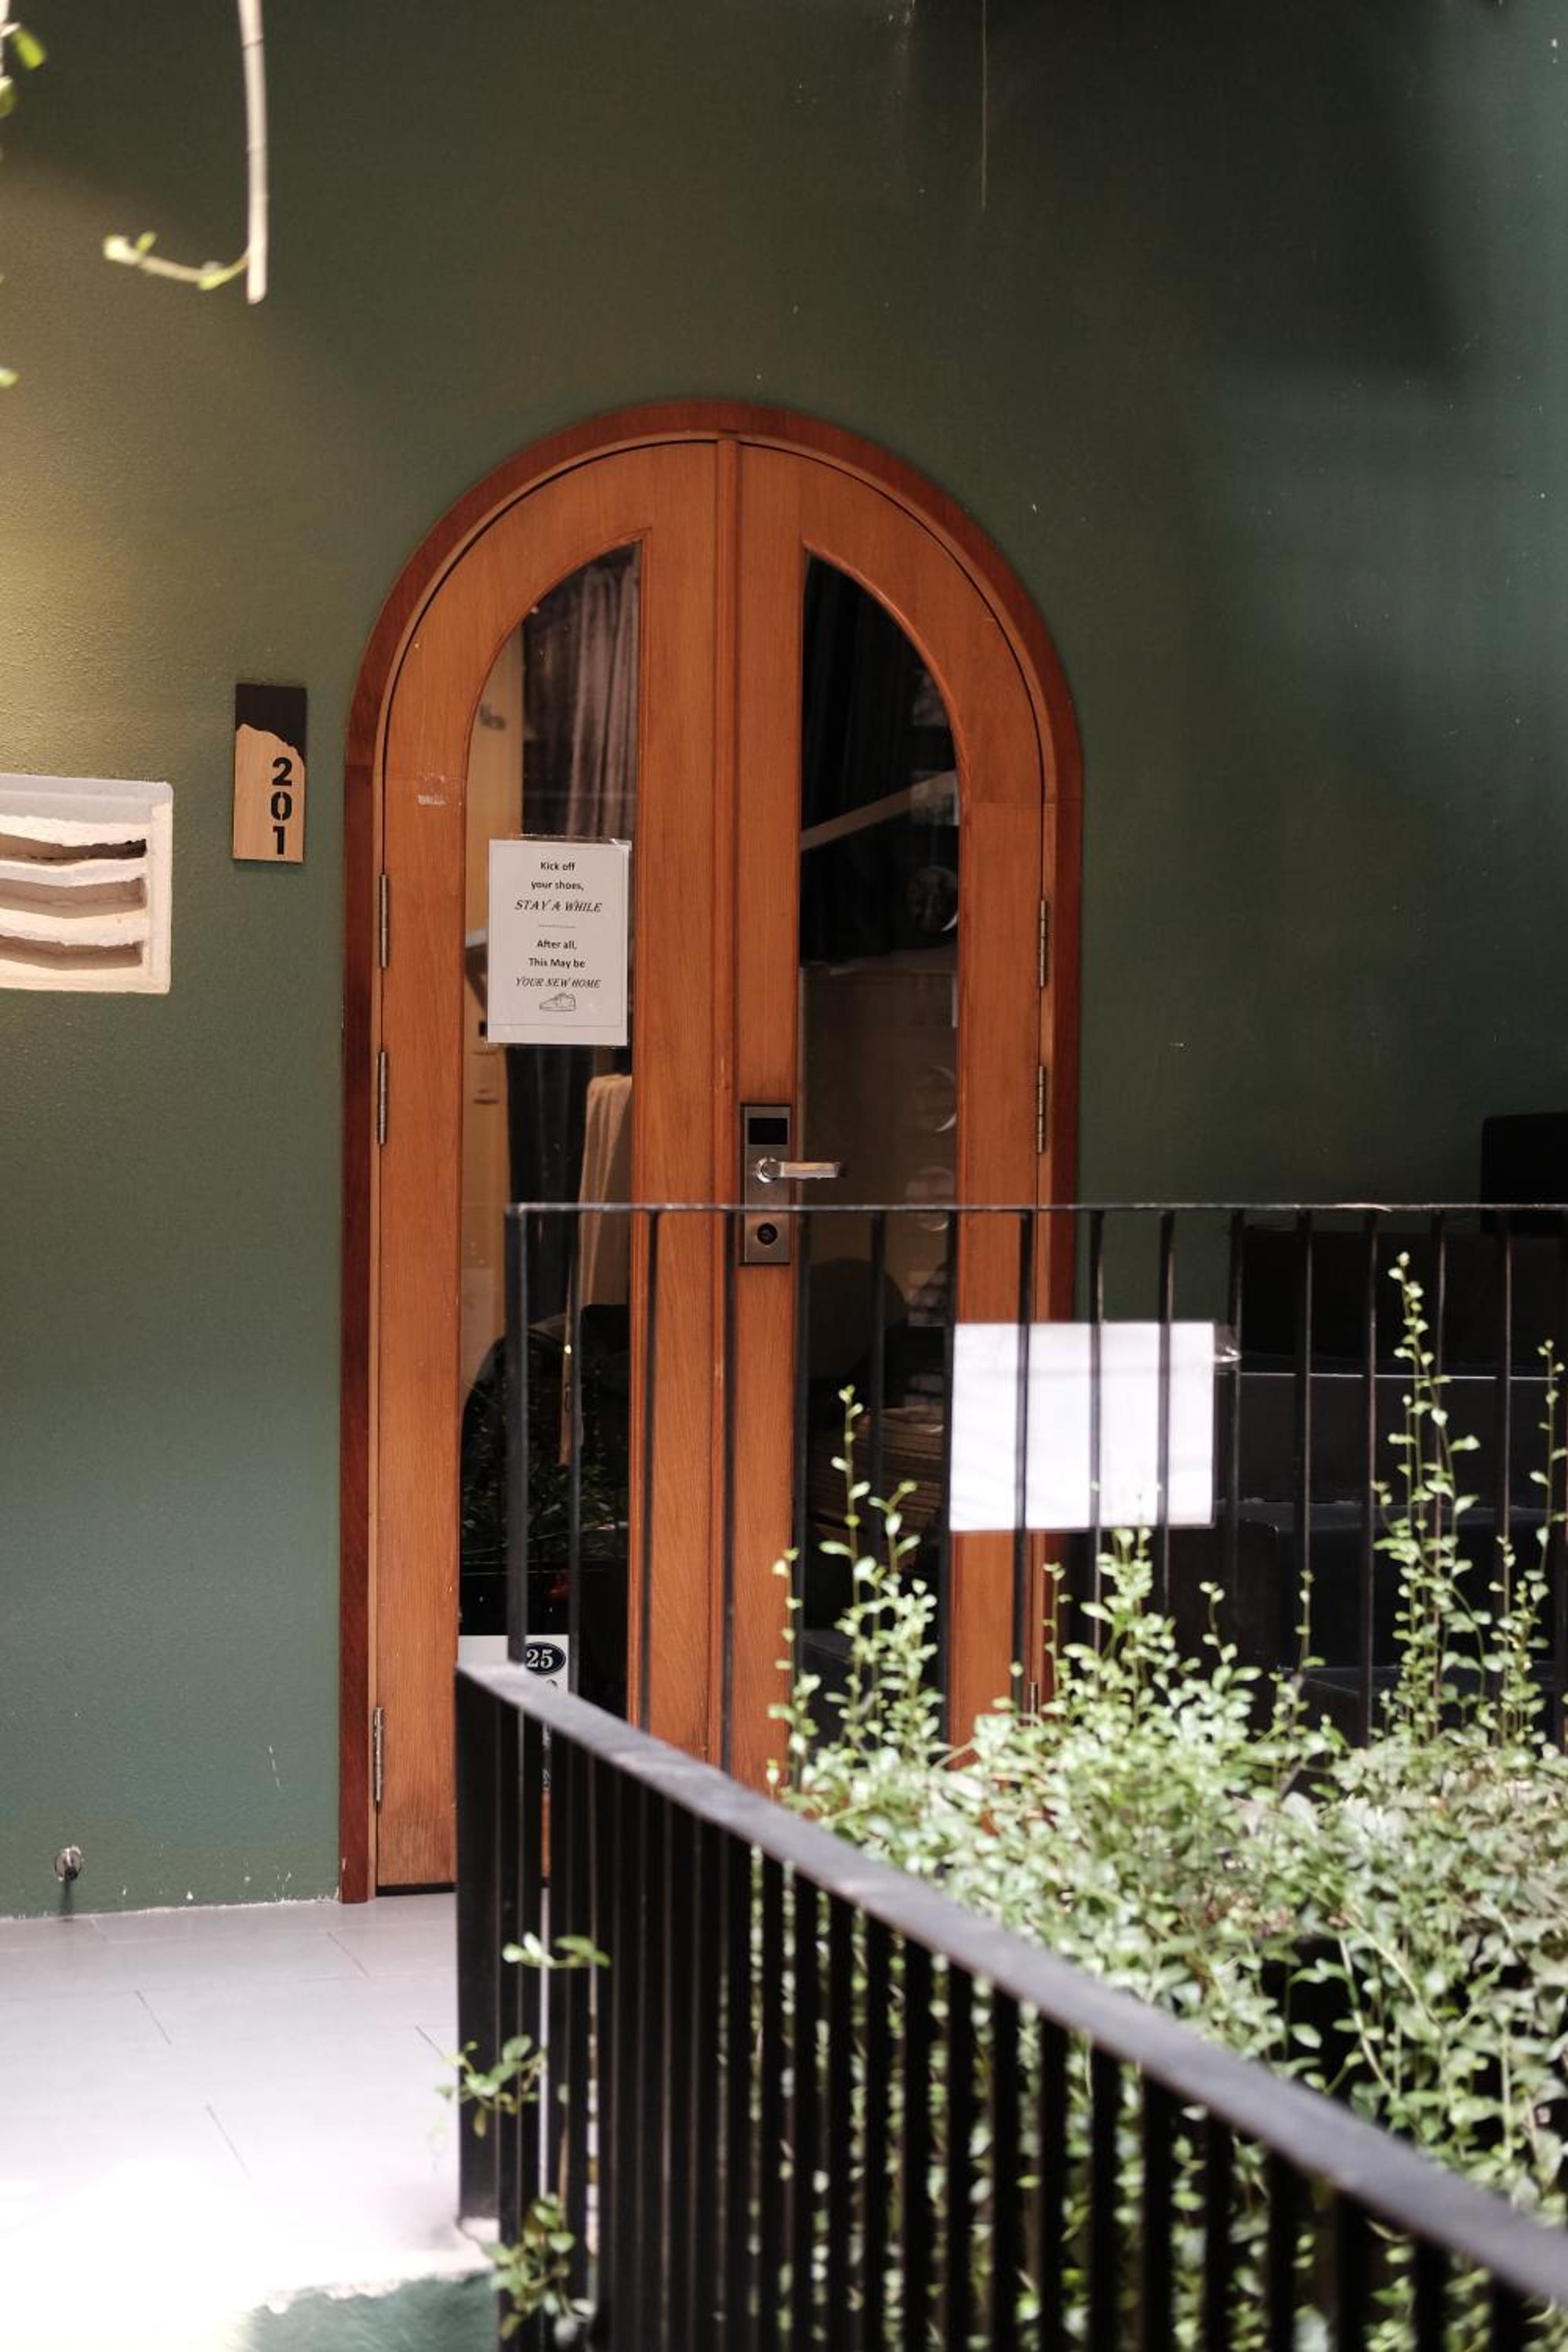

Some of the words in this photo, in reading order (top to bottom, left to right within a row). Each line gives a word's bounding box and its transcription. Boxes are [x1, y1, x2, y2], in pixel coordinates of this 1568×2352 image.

[270, 757, 292, 855] 201
[540, 861, 559, 871] Kick
[562, 862, 576, 871] off
[531, 881, 553, 890] your
[554, 880, 585, 891] shoes,
[514, 899, 552, 910] STAY
[551, 900, 561, 911] A
[565, 901, 603, 913] WHILE
[537, 939, 561, 949] After
[528, 957, 548, 967] This
[550, 958, 572, 969] May
[573, 959, 586, 968] be
[515, 977, 546, 987] YOUR
[544, 977, 572, 988] NEW
[572, 978, 602, 989] HOME
[526, 1649, 554, 1669] 25
